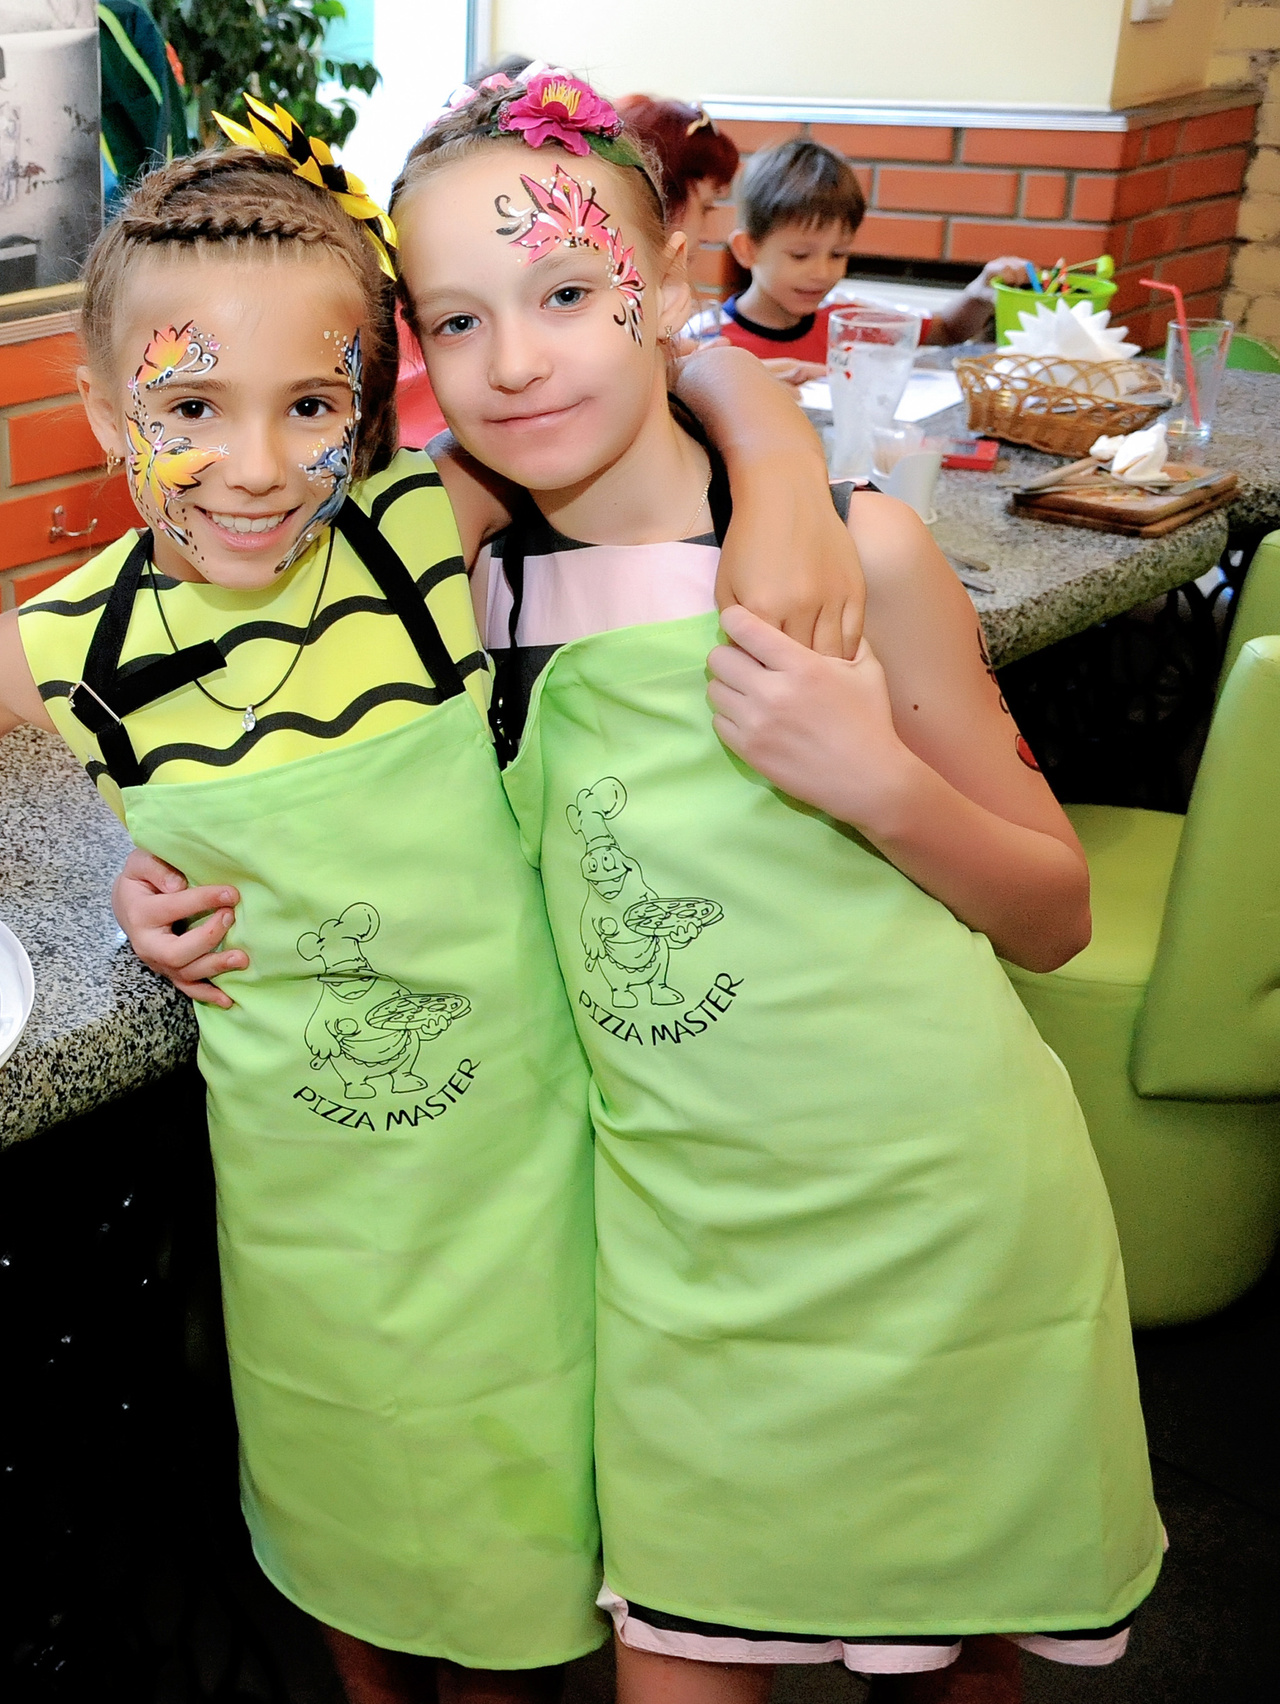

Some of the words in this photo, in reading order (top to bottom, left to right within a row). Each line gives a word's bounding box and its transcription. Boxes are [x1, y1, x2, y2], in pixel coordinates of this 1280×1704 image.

[578, 989, 644, 1046] PIZZA
[651, 972, 745, 1046] MASTER
[293, 1085, 375, 1132] PIZZA
[386, 1058, 481, 1132] MASTER
